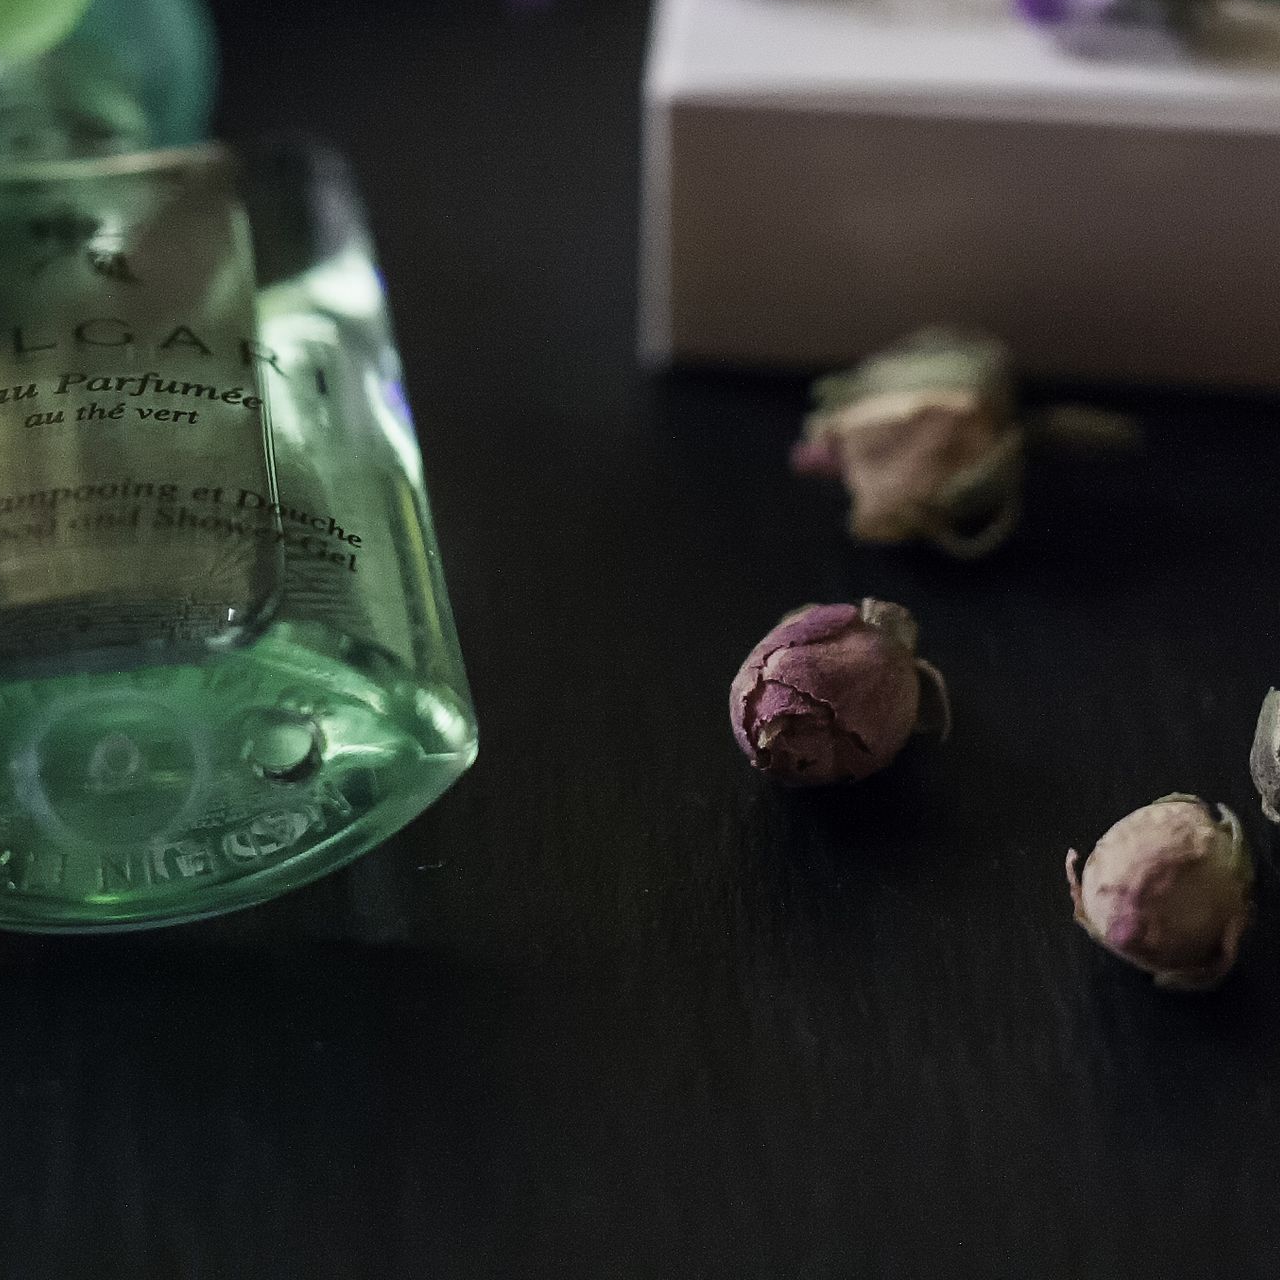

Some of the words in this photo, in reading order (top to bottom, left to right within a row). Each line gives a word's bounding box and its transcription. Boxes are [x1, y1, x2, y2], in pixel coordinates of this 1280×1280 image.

[52, 371, 266, 411] Parfumée
[23, 409, 64, 428] au
[74, 401, 125, 421] thé
[137, 405, 200, 425] vert
[191, 485, 223, 505] et
[237, 488, 363, 548] Douche
